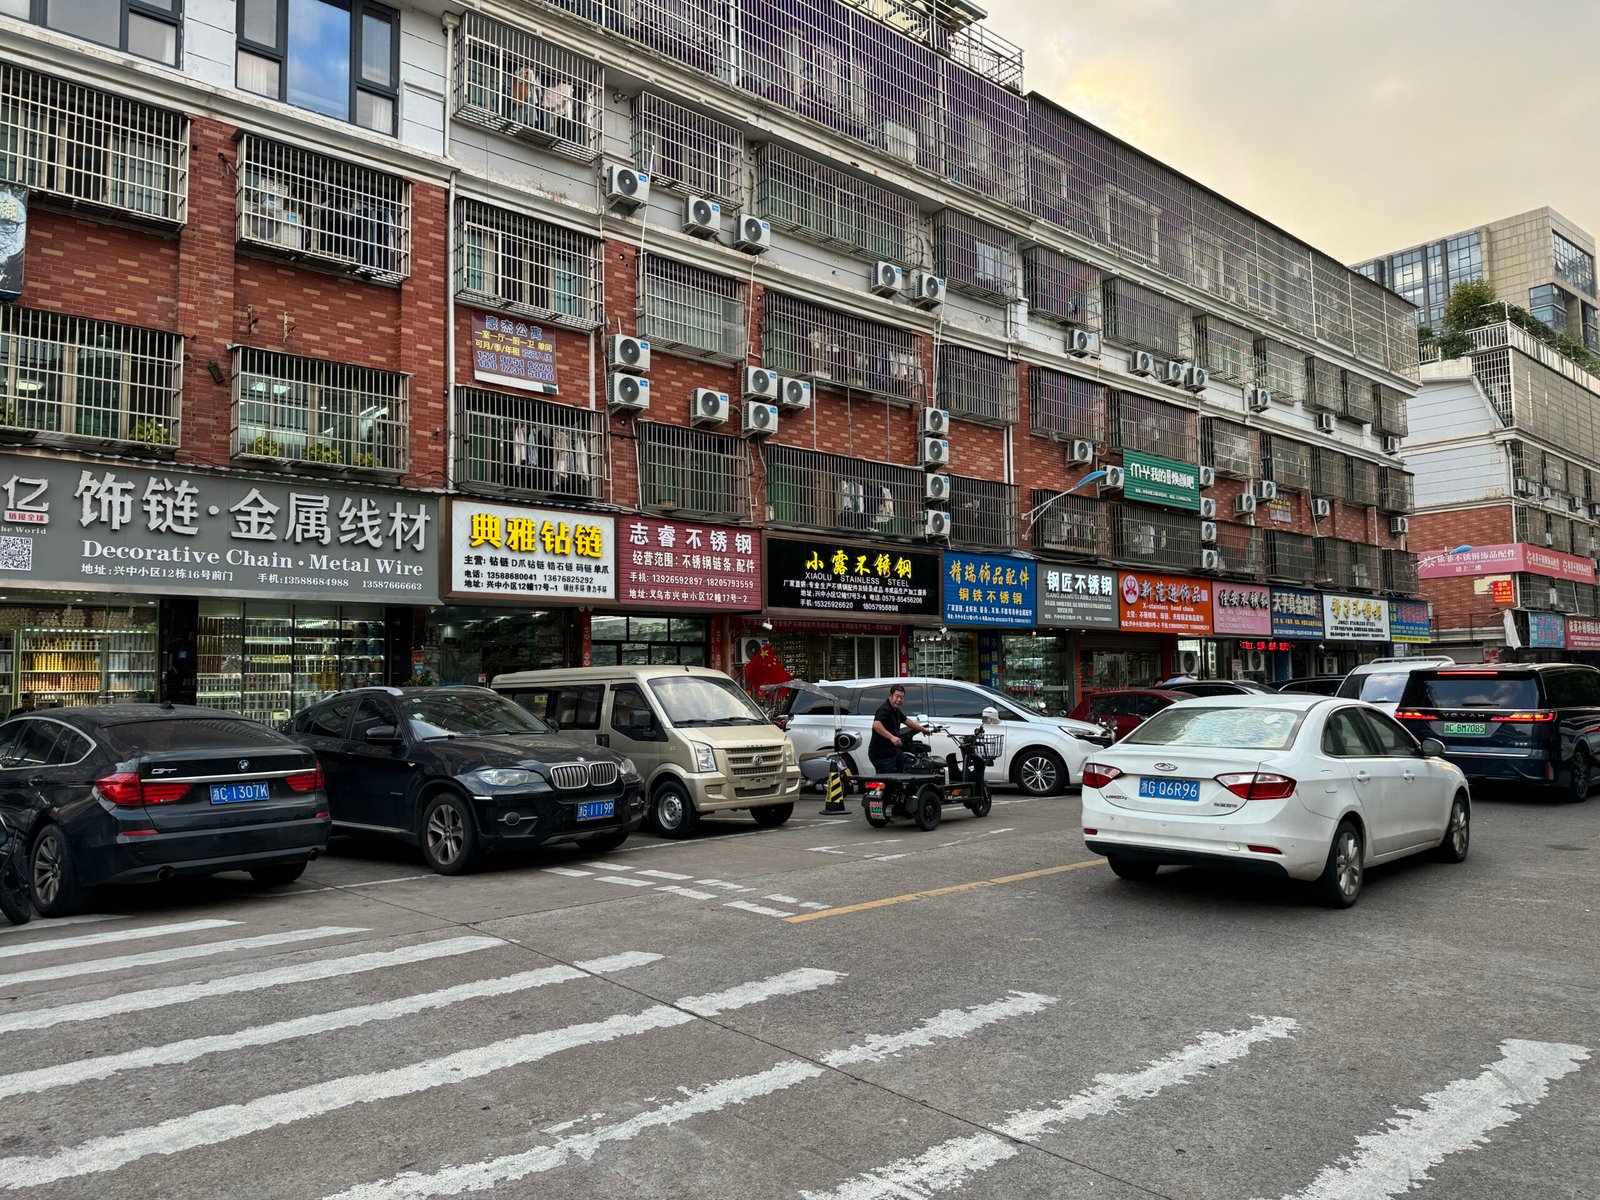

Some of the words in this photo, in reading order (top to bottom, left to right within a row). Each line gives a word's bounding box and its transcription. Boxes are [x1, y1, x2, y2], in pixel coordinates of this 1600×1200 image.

[16, 526, 47, 535] World
[469, 513, 604, 559] 典雅钻链
[629, 522, 753, 554] 志睿不锈钢
[81, 539, 220, 565] Decorative
[226, 549, 293, 568] Chain
[308, 553, 370, 573] Metal
[375, 558, 423, 576] Wire
[805, 550, 912, 579] 小露不锈钢
[486, 571, 537, 581] 13588680041
[544, 574, 594, 584] 13676825292
[706, 578, 754, 589] 18205793559
[805, 572, 832, 581] XIAOLU
[840, 575, 880, 585] STAINLESS
[887, 578, 910, 588] STEEL
[1047, 570, 1112, 595] 钢匠不锈钢
